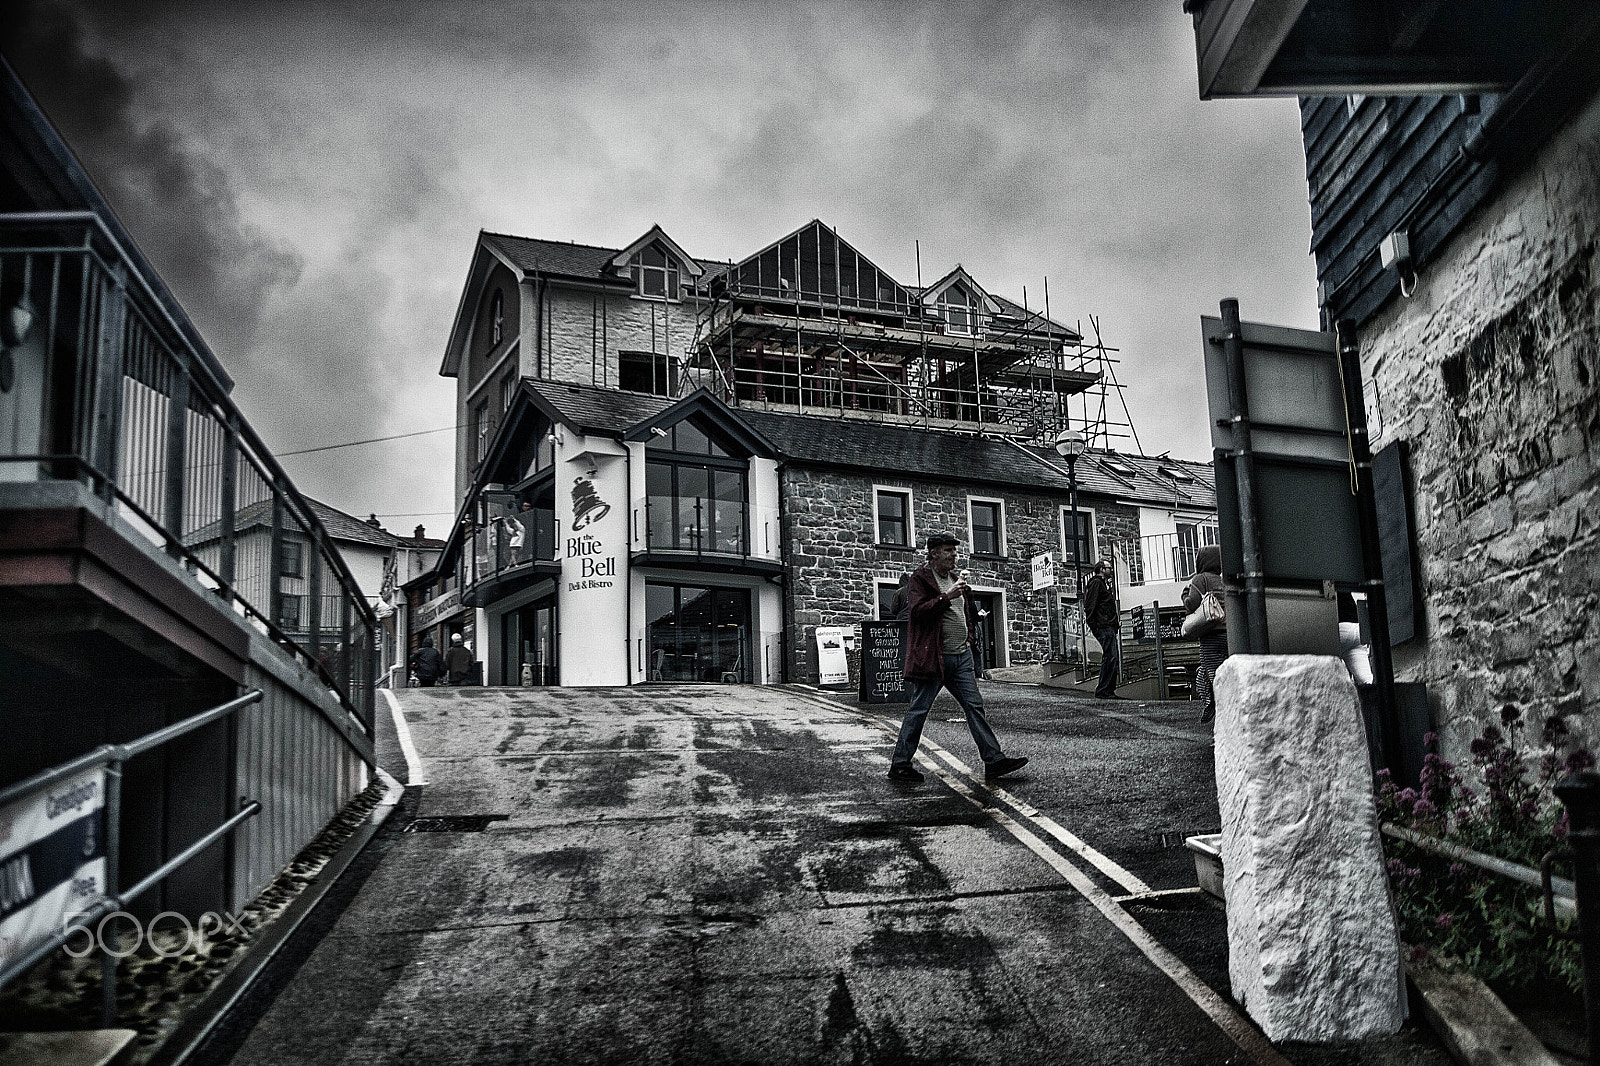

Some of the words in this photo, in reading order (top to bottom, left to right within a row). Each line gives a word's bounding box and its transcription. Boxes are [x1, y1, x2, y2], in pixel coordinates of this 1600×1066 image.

[566, 536, 602, 558] Blue
[581, 557, 616, 577] Bell
[581, 580, 588, 589] &
[588, 579, 613, 589] Bistro
[869, 627, 900, 638] FRESHLY
[874, 638, 900, 647] GROUND
[875, 670, 905, 682] COFFEE
[876, 680, 905, 692] INSIDE
